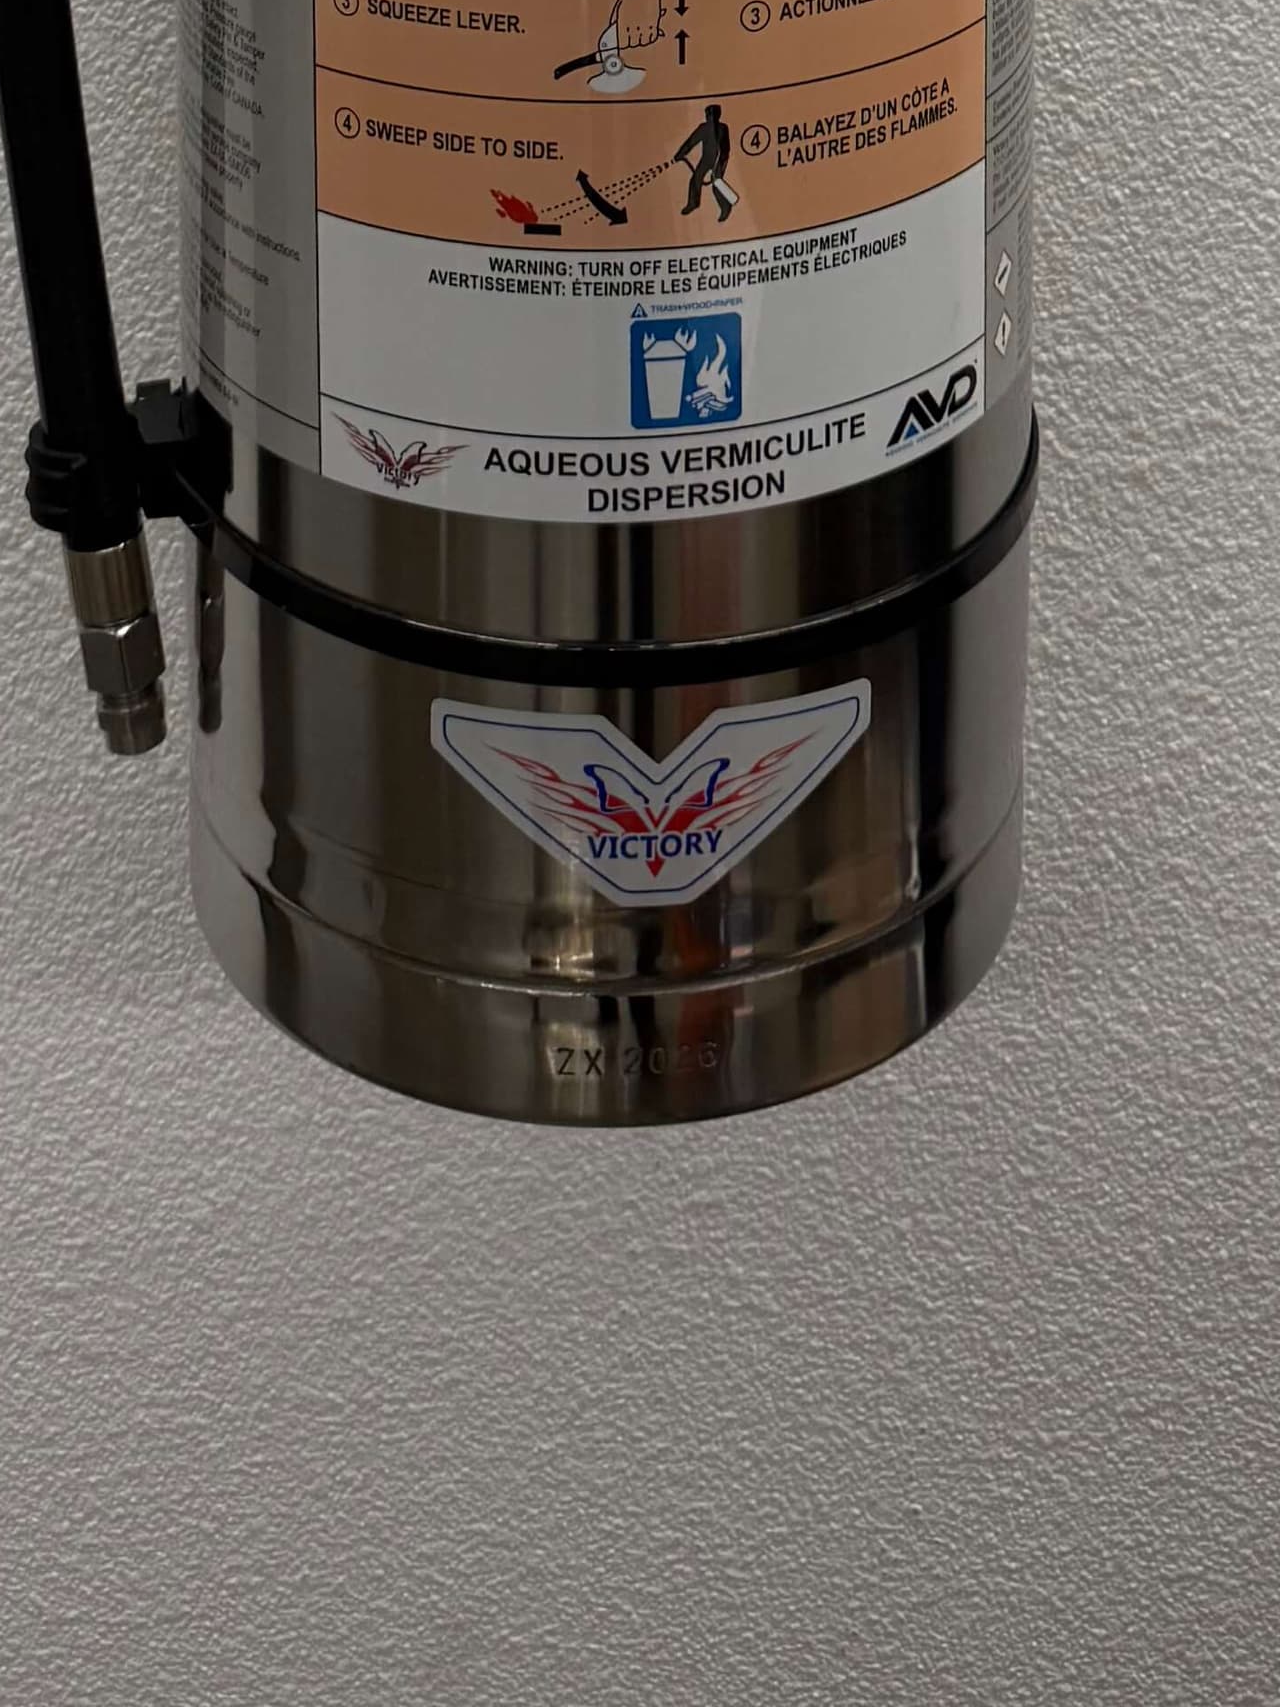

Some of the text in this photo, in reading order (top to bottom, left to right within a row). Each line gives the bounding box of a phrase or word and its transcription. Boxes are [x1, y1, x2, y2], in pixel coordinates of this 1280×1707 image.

[457, 10, 525, 34] LEVER.
[776, 110, 856, 146] BALAYEZ
[860, 100, 897, 126] D'UN
[940, 76, 950, 97] A
[777, 96, 958, 169] L'AUTRE DES FLAMMES.
[366, 119, 427, 146] SWEEP
[433, 131, 475, 154] SIDE
[480, 137, 507, 157] TO
[513, 140, 563, 160] SIDE.
[428, 229, 908, 298] AVERTISSEMENT: ÉTEINDRE LES ÉQUIPEMENTS ÉLECTRIQUES
[489, 227, 858, 277] WARNING: TURN OFF ELECTRICAL EQUIPMENT
[886, 364, 978, 448] AVD
[484, 448, 650, 477] AQUEOUS
[662, 409, 867, 475] VERMICULITE
[588, 470, 784, 512] DISPERSION
[586, 831, 723, 861] VICTORY
[556, 1048, 603, 1076] ZX
